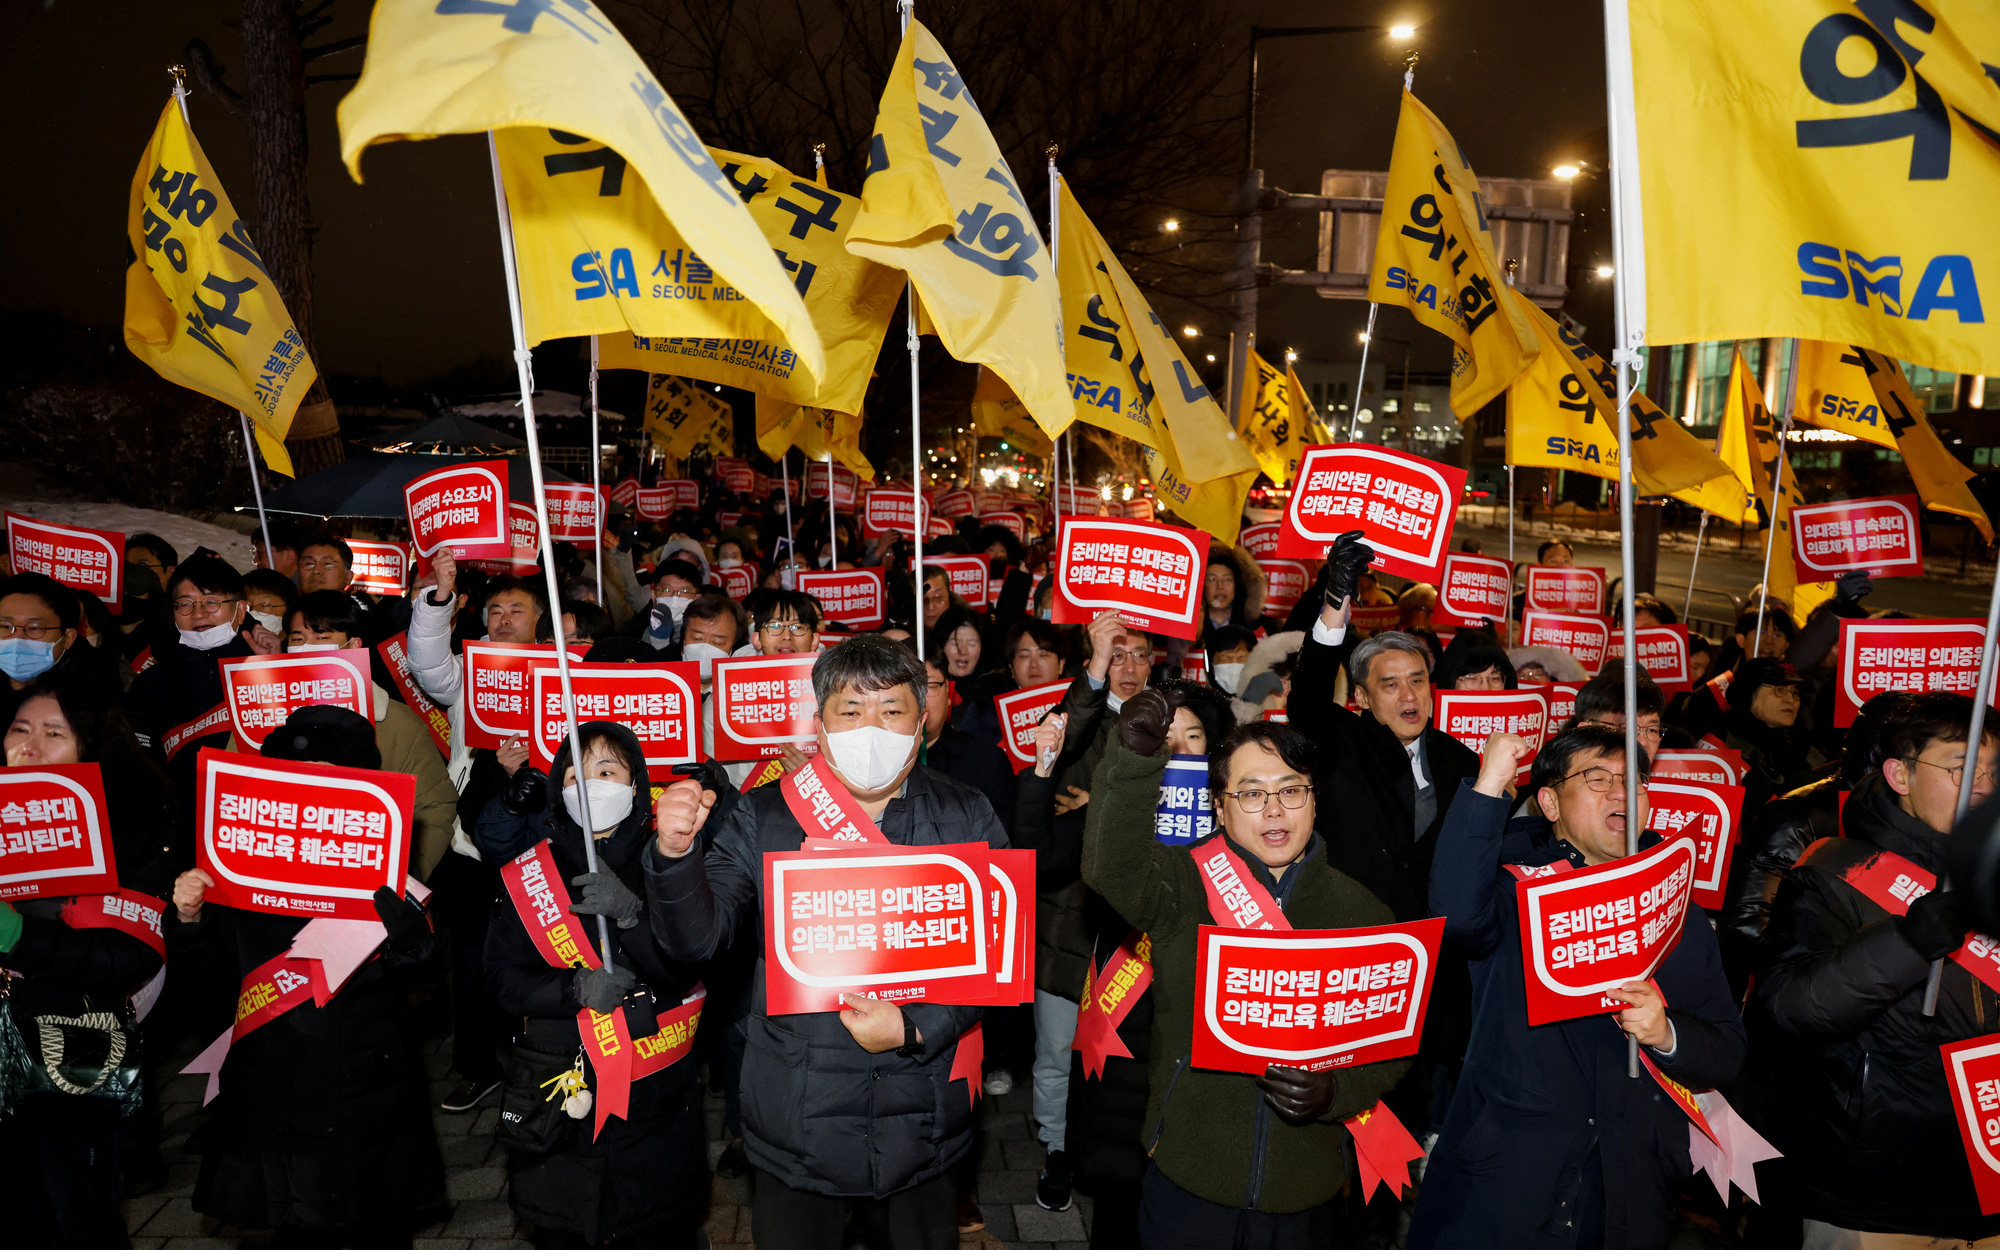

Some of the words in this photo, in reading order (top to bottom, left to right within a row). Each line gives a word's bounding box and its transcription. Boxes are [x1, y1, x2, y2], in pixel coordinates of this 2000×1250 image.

[652, 285, 707, 301] SEOUL
[1797, 241, 1985, 324] SMA
[680, 346, 720, 361] MEDICAL
[721, 354, 791, 379] ASSOCIATION
[1821, 394, 1878, 427] SMA
[1546, 436, 1600, 464] SMA
[412, 492, 441, 521] 비과학적
[441, 485, 493, 505] 수요조사
[1307, 470, 1372, 495] 준비안된
[1371, 476, 1441, 517] 의대증원
[419, 516, 433, 537] 즉각
[433, 506, 480, 530] 폐기하라
[1301, 494, 1365, 520] 의학교육
[1365, 499, 1434, 541] 훼손된다
[1804, 520, 1853, 539] 의대정원
[1853, 515, 1904, 533] 졸속확대
[15, 535, 54, 560] 준비안된
[55, 546, 108, 568] 의대증원
[1071, 542, 1129, 565] 준비안된
[1131, 546, 1191, 577] 의대증원
[1806, 537, 1855, 556] 의료체계
[1855, 533, 1906, 551] 붕괴된다
[54, 564, 108, 586] 훼손된다
[1068, 565, 1126, 588] 의학교육
[1127, 569, 1187, 600] 훼손된다
[1451, 570, 1488, 588] 준비안된
[1448, 587, 1487, 603] 의학교육
[1532, 627, 1573, 644] 준비안된
[1573, 630, 1604, 647] 의대증원
[1859, 647, 1926, 668] 준비안된
[236, 683, 287, 706] 준비안된
[289, 678, 353, 703] 의대증원
[476, 668, 523, 691] 준비안된
[729, 681, 785, 702] 일방적인
[1857, 670, 1925, 692] 의학교육
[240, 706, 287, 729] 의학교육
[476, 691, 523, 715] 의학교육
[545, 693, 610, 717] 준안된
[613, 692, 681, 717] 의대증원
[730, 704, 787, 725] 국민건강
[1450, 715, 1506, 735] 의대정원
[1507, 711, 1543, 734] 졸속확대
[793, 762, 847, 833] 일방적인
[219, 793, 299, 830] 준비안된
[301, 805, 387, 839] 의대증원
[217, 826, 296, 862] 의학교육
[298, 837, 384, 871] 훼손된다
[252, 892, 290, 909] KMA
[290, 898, 336, 910] 대한의사협회
[520, 859, 562, 928] 확대추진
[790, 888, 877, 920] 준비안된
[880, 882, 966, 915] 의대증원
[1548, 895, 1637, 941] 준비안된
[1639, 858, 1690, 917] 의대증원
[791, 923, 878, 955] 의학교육
[882, 916, 969, 949] 훼손된다
[1551, 929, 1639, 970] 의학교육
[1641, 889, 1686, 949] 훼손된다
[880, 986, 926, 998] 대한의사협회
[1098, 957, 1146, 1016] 위협한다
[1225, 967, 1320, 998] 준비안된
[1324, 958, 1413, 995] 의대증원
[1222, 997, 1317, 1030] 의학교육
[1324, 989, 1406, 1029] 훼손된다
